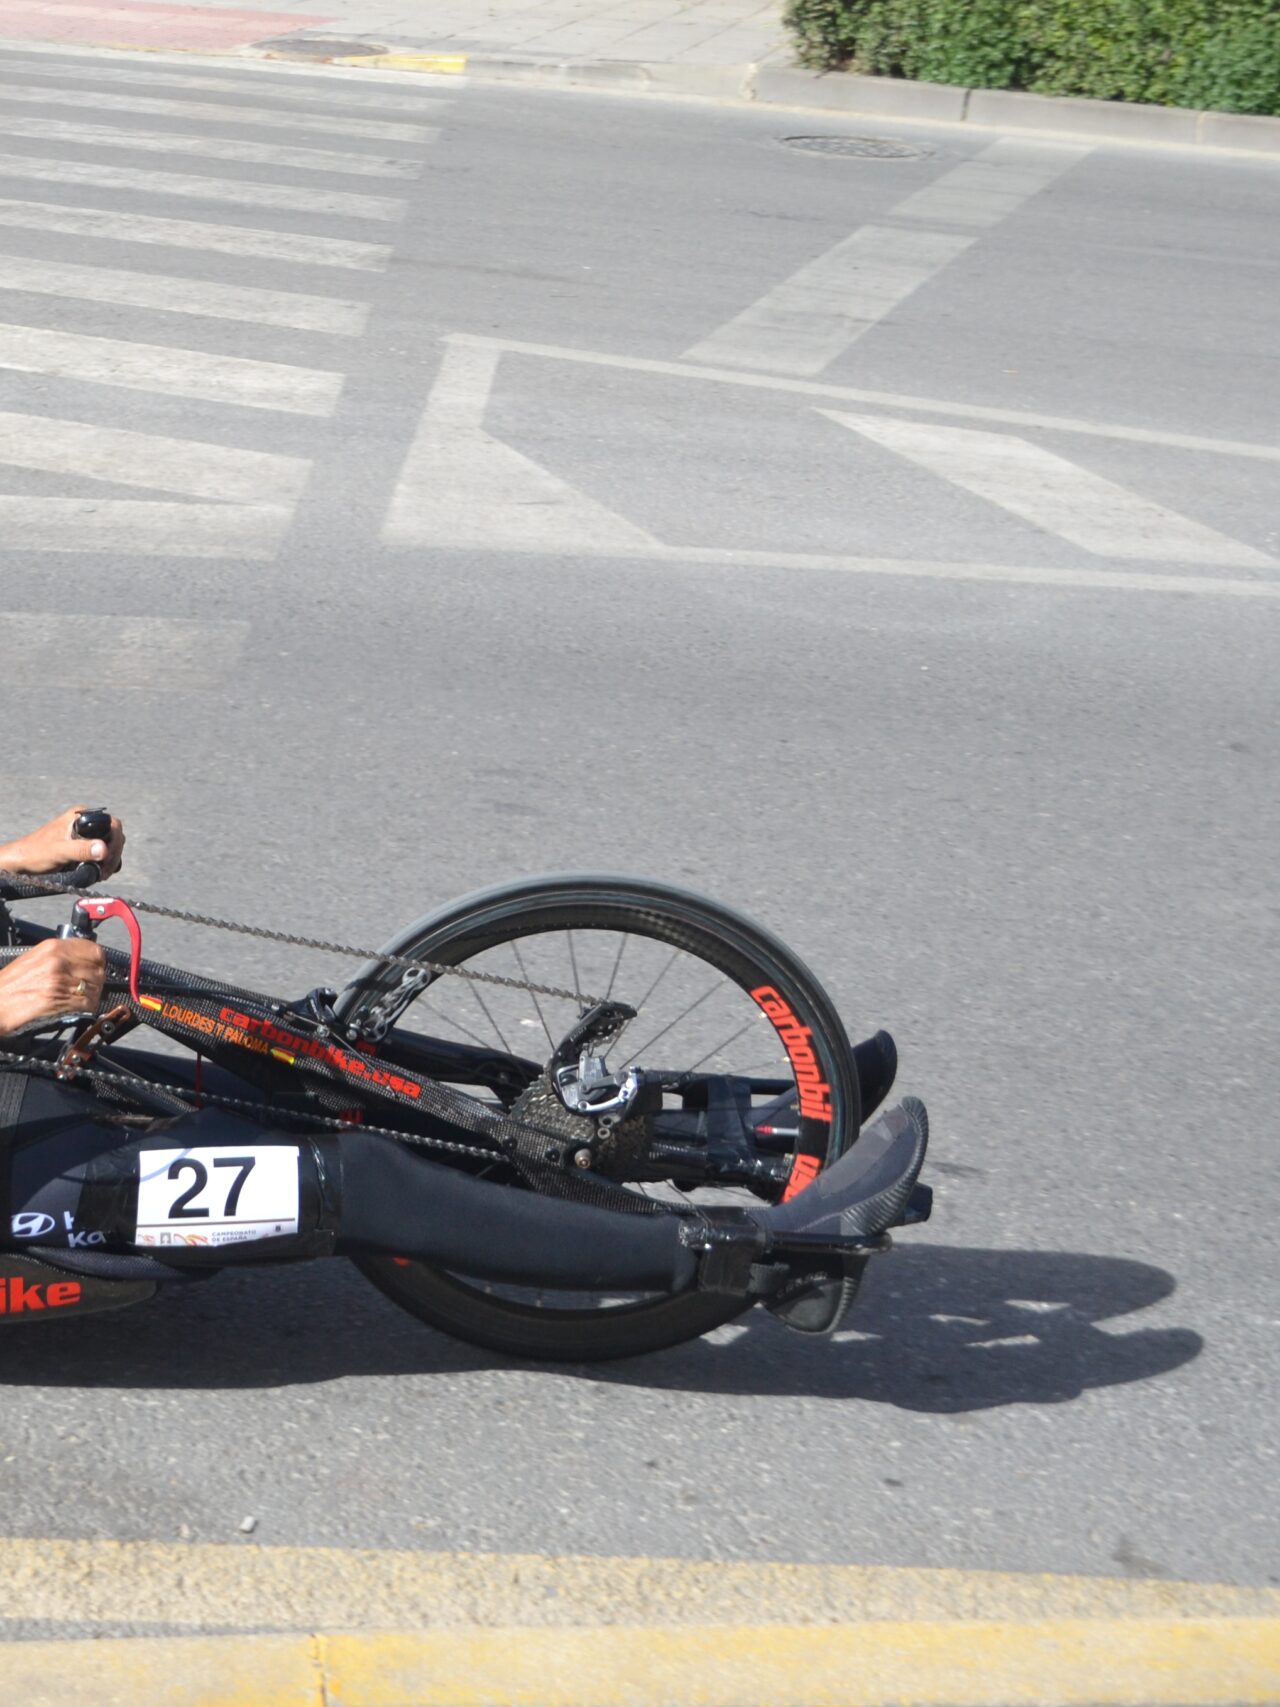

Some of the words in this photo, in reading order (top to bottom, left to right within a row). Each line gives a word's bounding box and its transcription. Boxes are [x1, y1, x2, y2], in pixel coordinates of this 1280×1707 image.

[162, 1004, 215, 1034] LOURDES
[224, 1026, 270, 1056] PALOMA
[167, 1156, 256, 1219] 27
